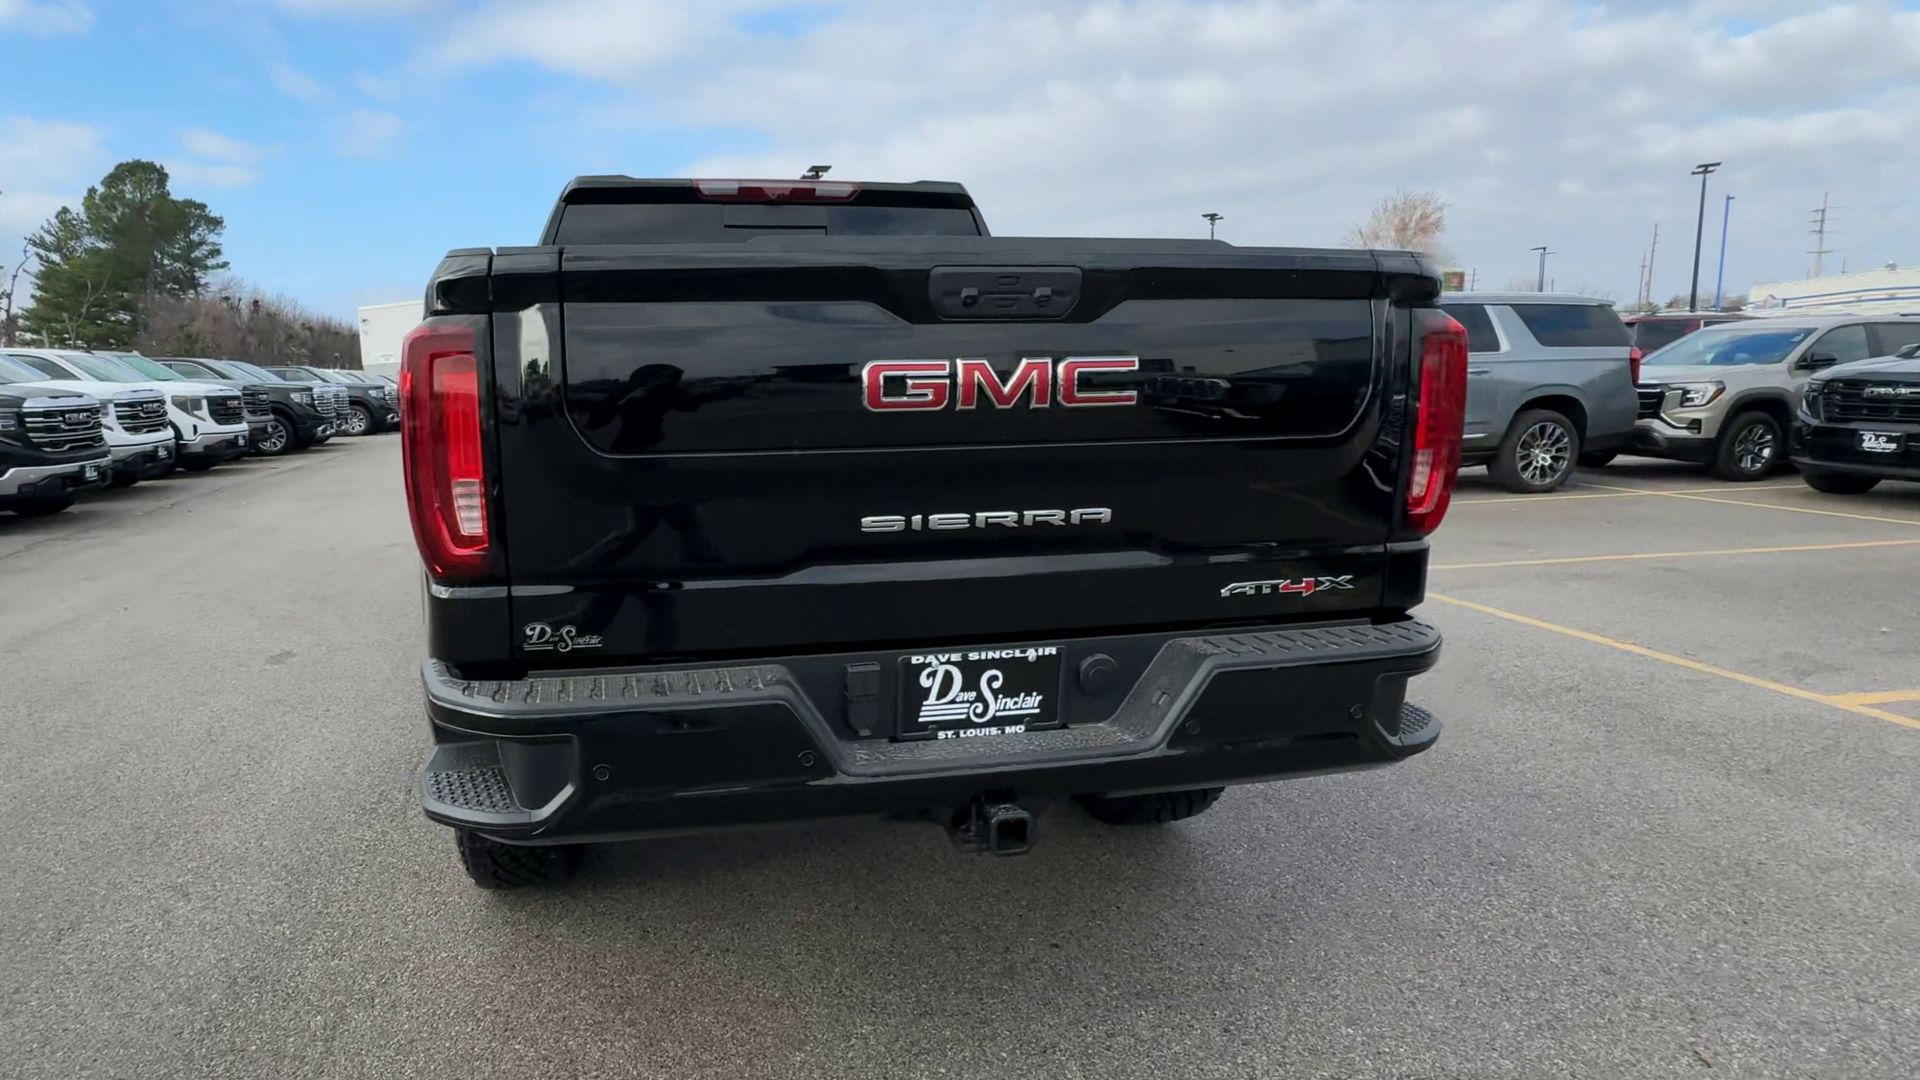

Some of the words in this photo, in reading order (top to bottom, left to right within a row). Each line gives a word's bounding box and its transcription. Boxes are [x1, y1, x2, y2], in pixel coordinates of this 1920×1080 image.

[863, 356, 1139, 411] GMC
[861, 508, 1112, 532] SIERRA
[1221, 575, 1354, 597] AT4X
[911, 653, 962, 664] DAVE
[967, 647, 1057, 660] SINCLAIR
[919, 664, 977, 705] Dave
[969, 669, 1043, 723] Sinclair
[937, 730, 956, 739] ST.
[1005, 725, 1026, 735] MO
